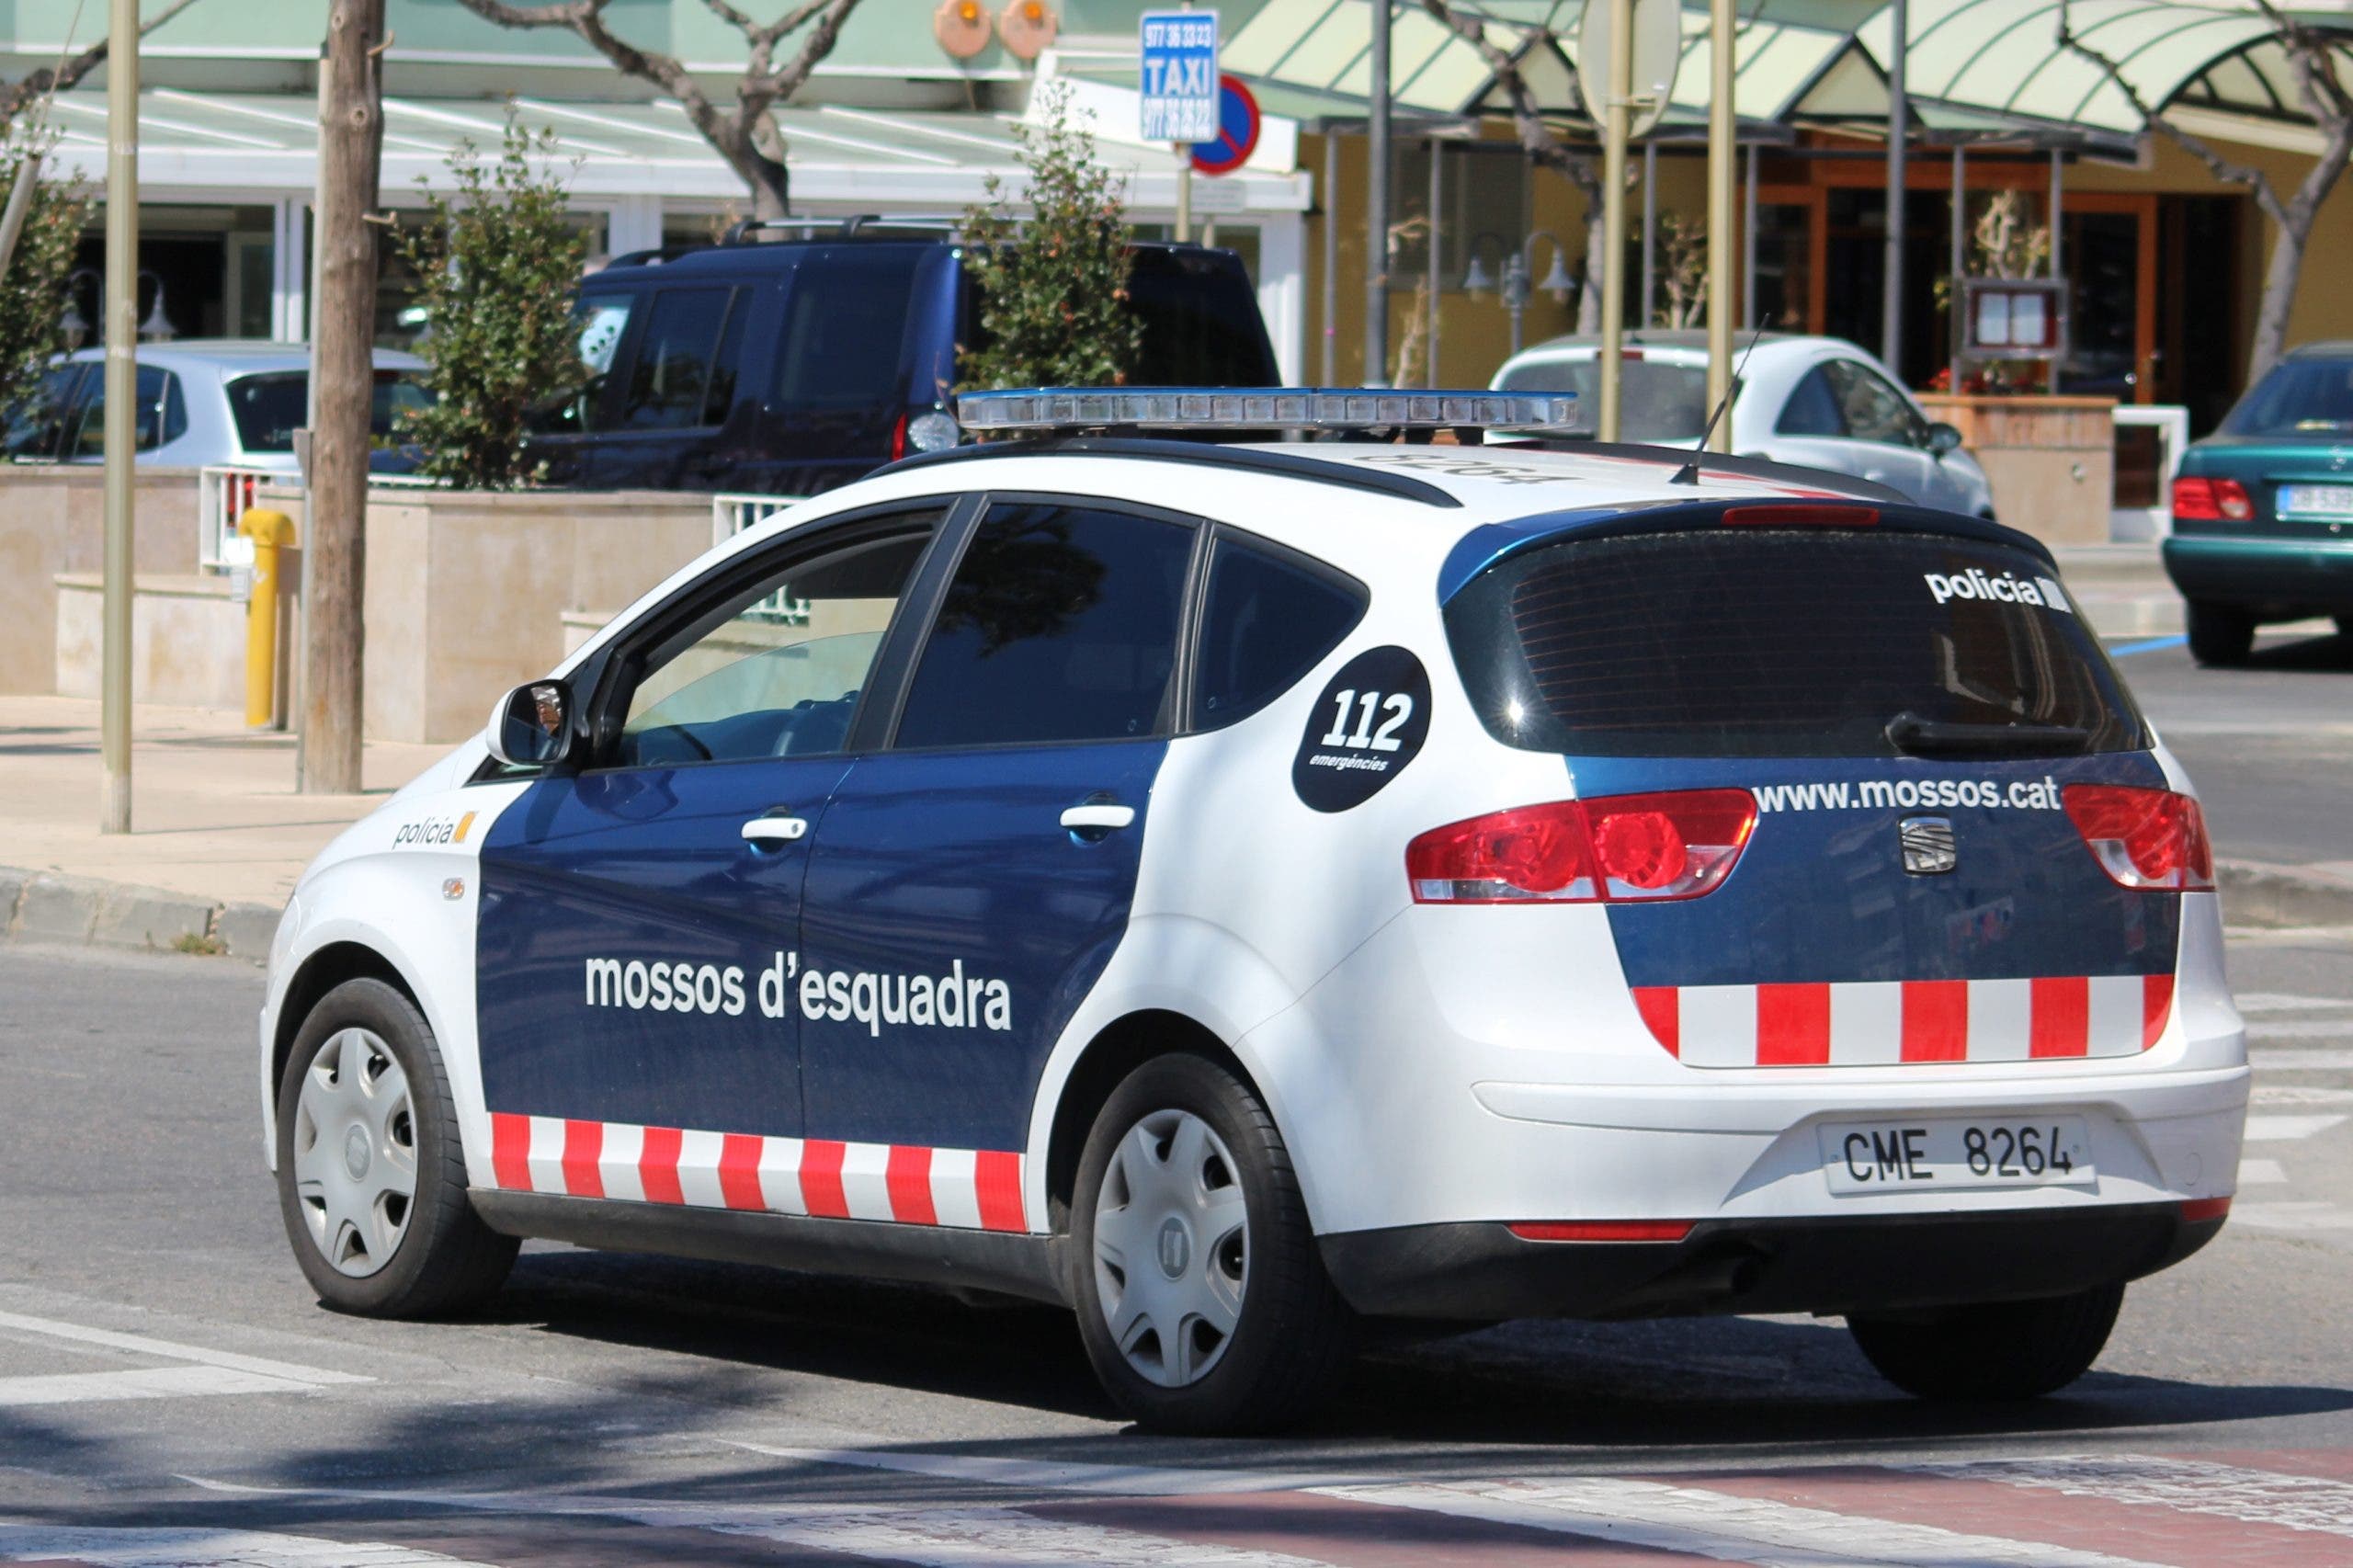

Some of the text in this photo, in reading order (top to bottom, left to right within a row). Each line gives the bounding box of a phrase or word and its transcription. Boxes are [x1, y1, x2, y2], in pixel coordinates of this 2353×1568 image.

[1145, 24, 1165, 47] 977
[1197, 24, 1211, 47] 23
[1145, 59, 1210, 95] TAXI
[1924, 568, 2044, 604] policia
[1321, 689, 1413, 752] 112
[1751, 776, 2062, 812] www.mossos.cat
[392, 816, 454, 850] policia
[585, 951, 1012, 1036] mossos d'esquadra
[1843, 1126, 2072, 1181] CME 8264
